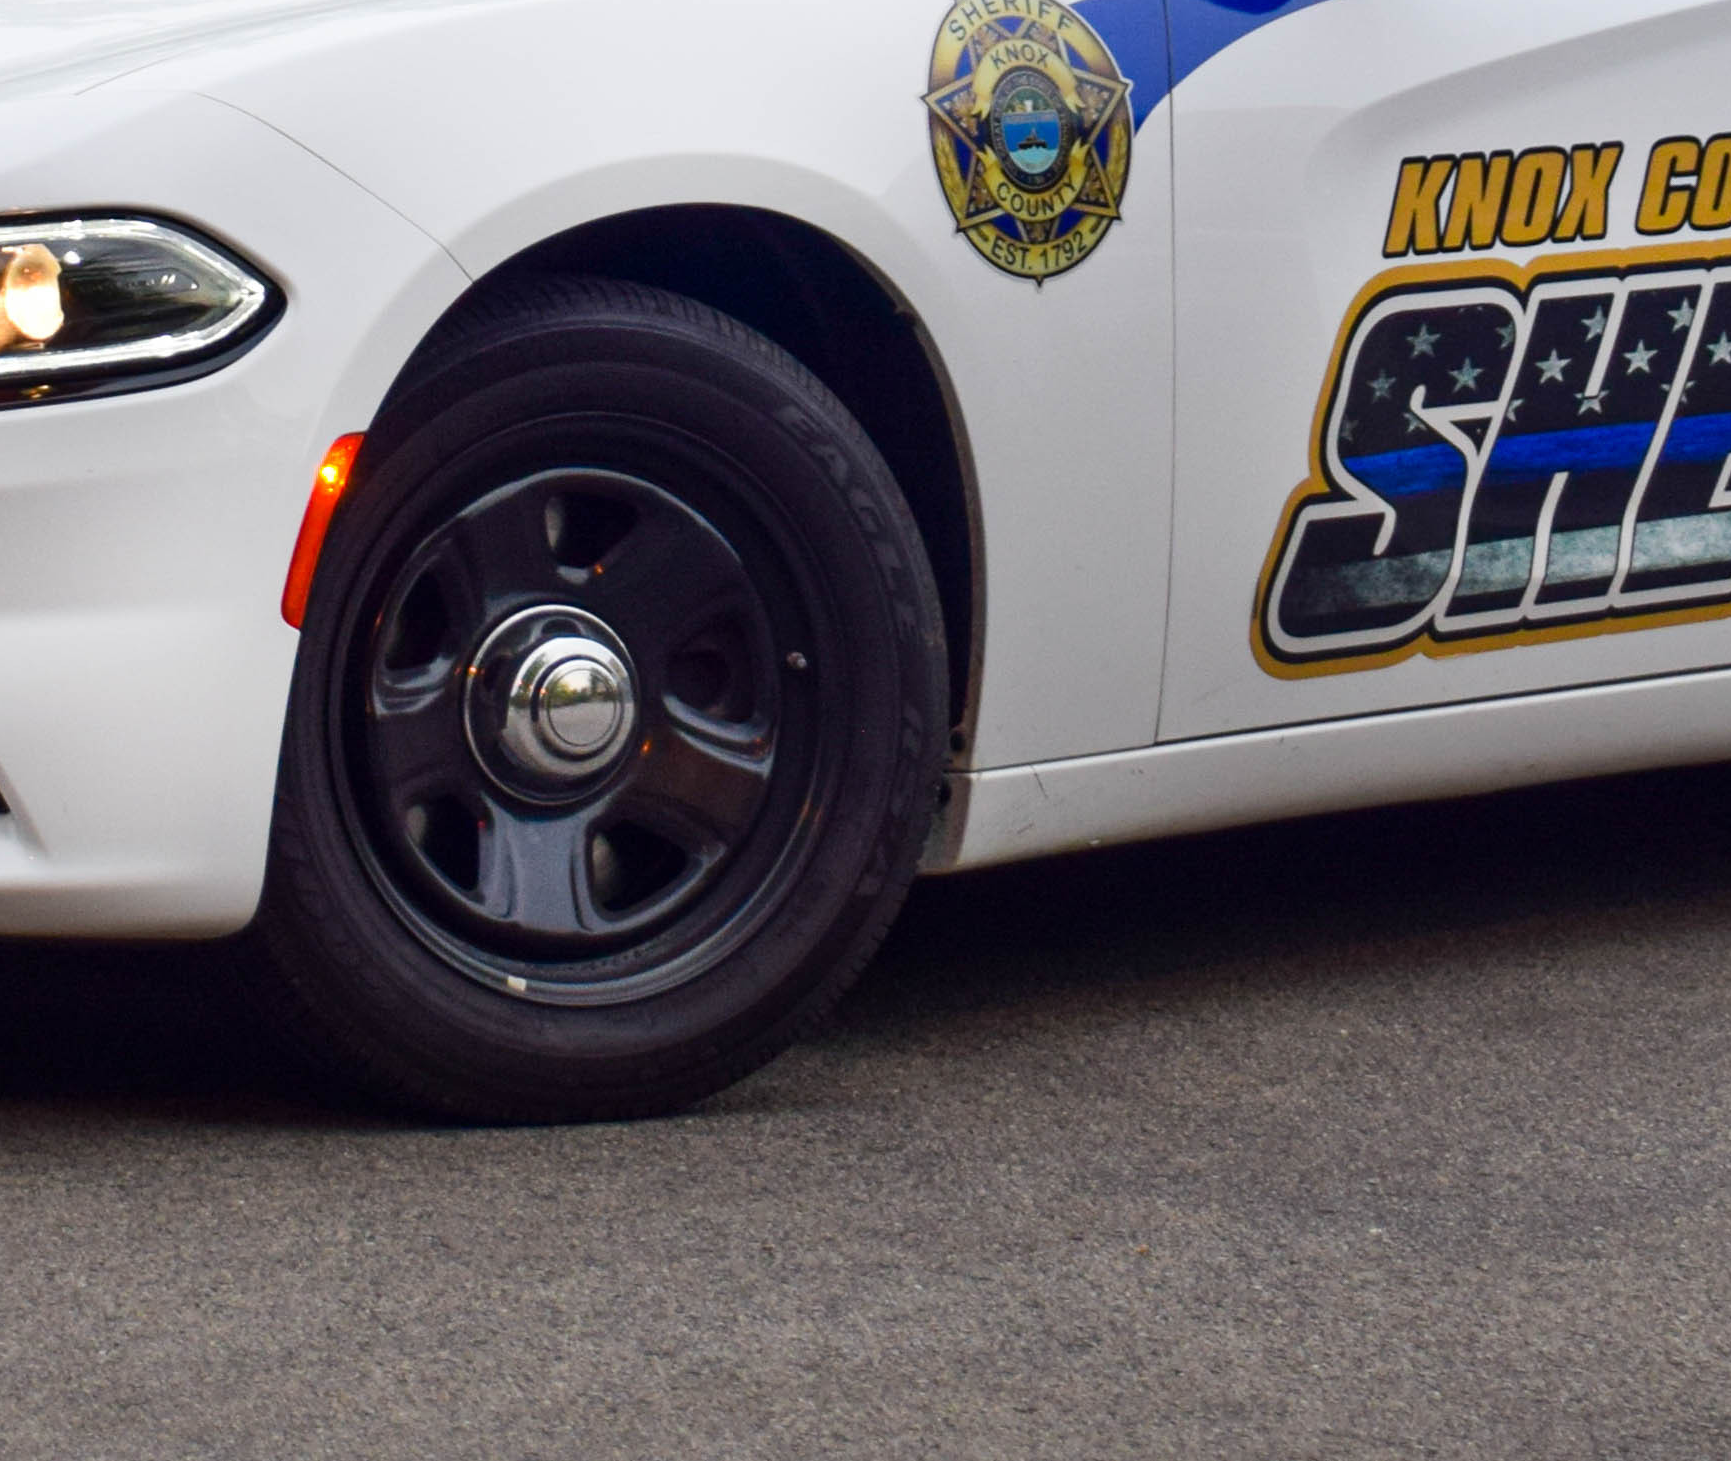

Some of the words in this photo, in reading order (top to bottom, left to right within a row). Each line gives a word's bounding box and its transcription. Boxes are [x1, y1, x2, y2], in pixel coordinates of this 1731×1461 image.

[992, 44, 1050, 71] KNOX
[996, 180, 1077, 217] COUNTY
[1382, 141, 1624, 258] KNOX
[991, 237, 1033, 271] EST.
[1039, 230, 1088, 271] 1792
